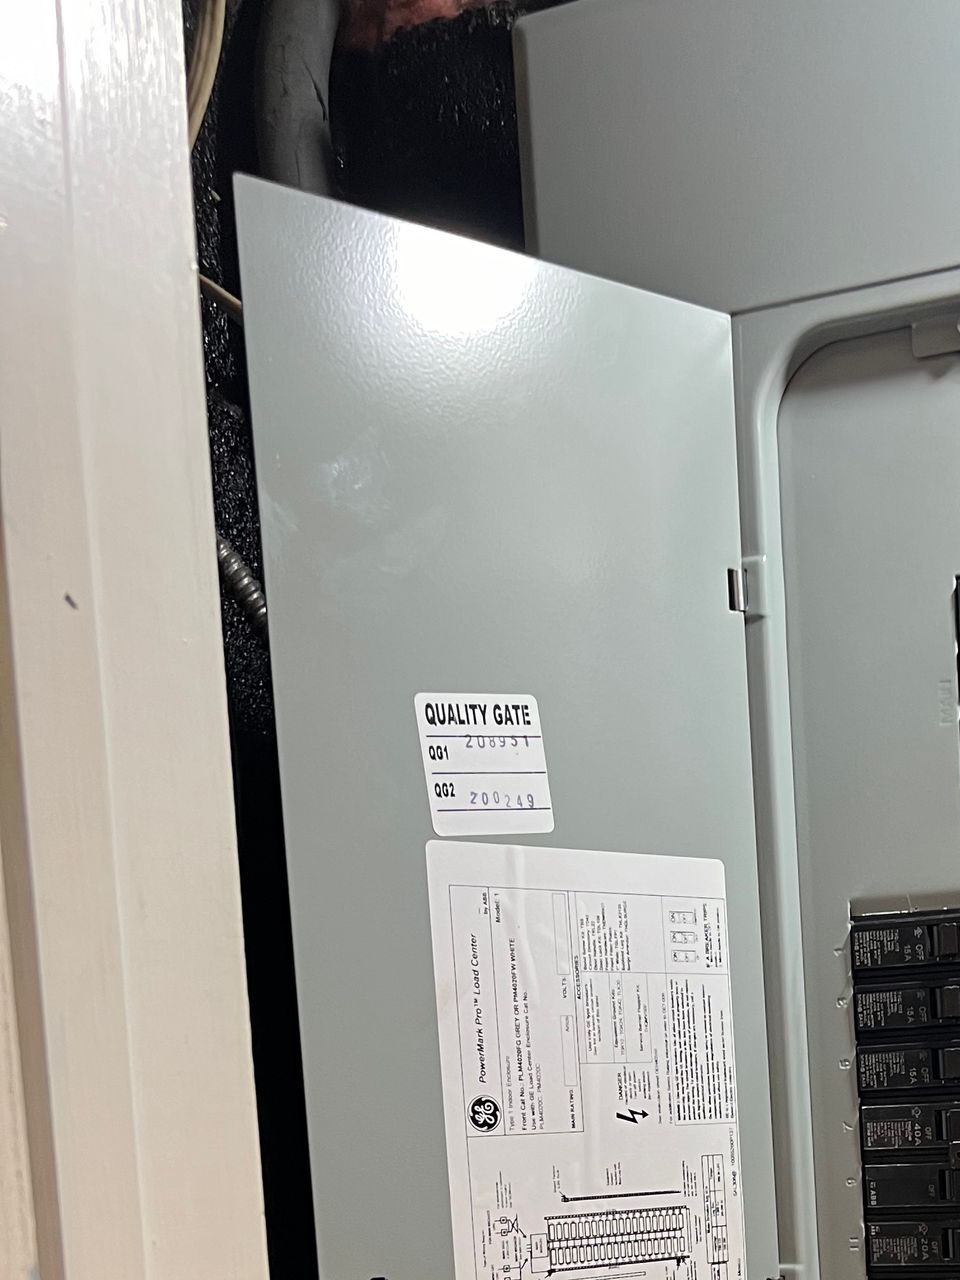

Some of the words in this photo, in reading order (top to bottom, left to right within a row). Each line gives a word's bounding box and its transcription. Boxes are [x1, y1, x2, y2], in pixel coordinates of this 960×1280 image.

[425, 703, 487, 726] QUALITY
[493, 704, 531, 725] GATE
[465, 735, 529, 748] 208951
[428, 745, 449, 760] QG1
[434, 783, 455, 798] QG2
[470, 791, 534, 808] 200249
[470, 933, 478, 966] Center
[916, 944, 924, 960] OFF
[472, 970, 481, 995] Load
[514, 1005, 519, 1015] OR
[919, 1006, 927, 1022] OFF
[476, 1028, 487, 1083] PowerMark
[921, 1067, 929, 1083] OFF
[914, 1123, 922, 1146] 40A
